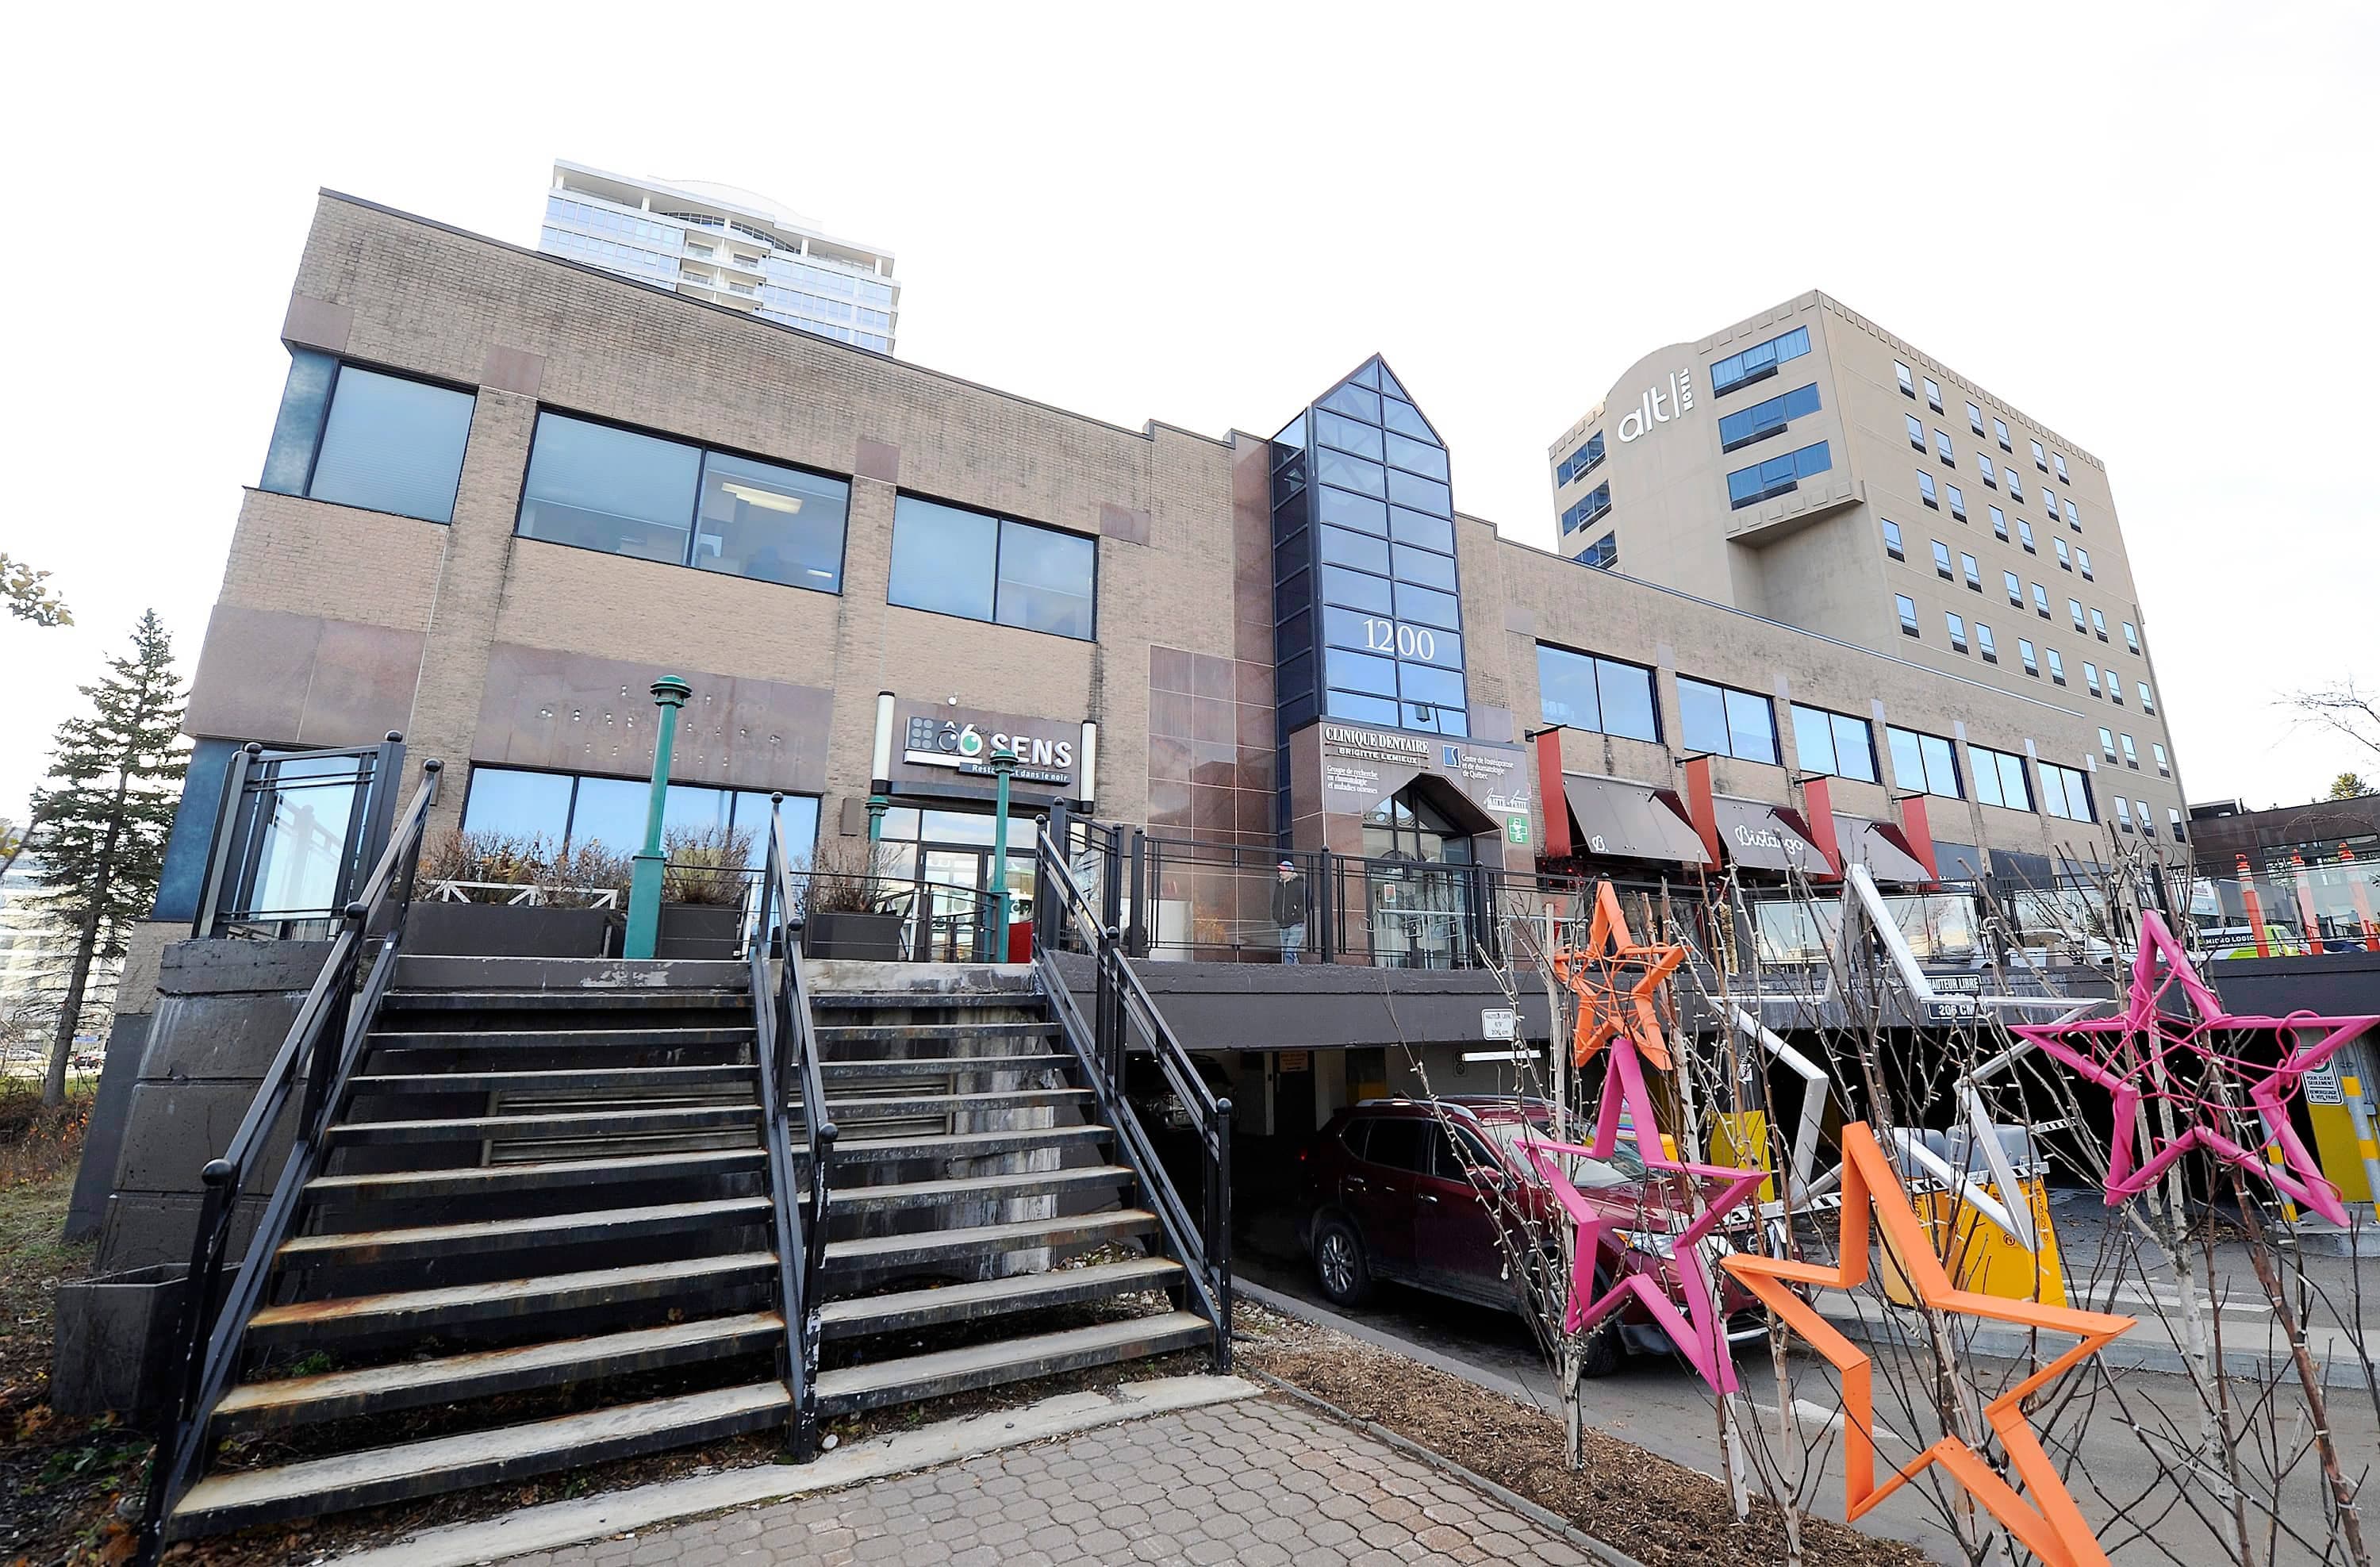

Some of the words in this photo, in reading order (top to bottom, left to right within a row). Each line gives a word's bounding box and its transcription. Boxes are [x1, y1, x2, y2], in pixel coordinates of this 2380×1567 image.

[1618, 386, 1670, 442] alt
[1363, 618, 1435, 660] 1200
[991, 732, 1073, 769] SENS
[1325, 727, 1377, 747] CLINIQUE
[1379, 735, 1430, 754] DENTAIRE
[1338, 747, 1379, 759] BRIGITTE
[1380, 752, 1418, 764] LEMIEUX
[1020, 770, 1042, 779] dans
[1042, 771, 1049, 780] le
[1958, 977, 1979, 989] LIBRE
[1938, 1004, 1957, 1016] 206
